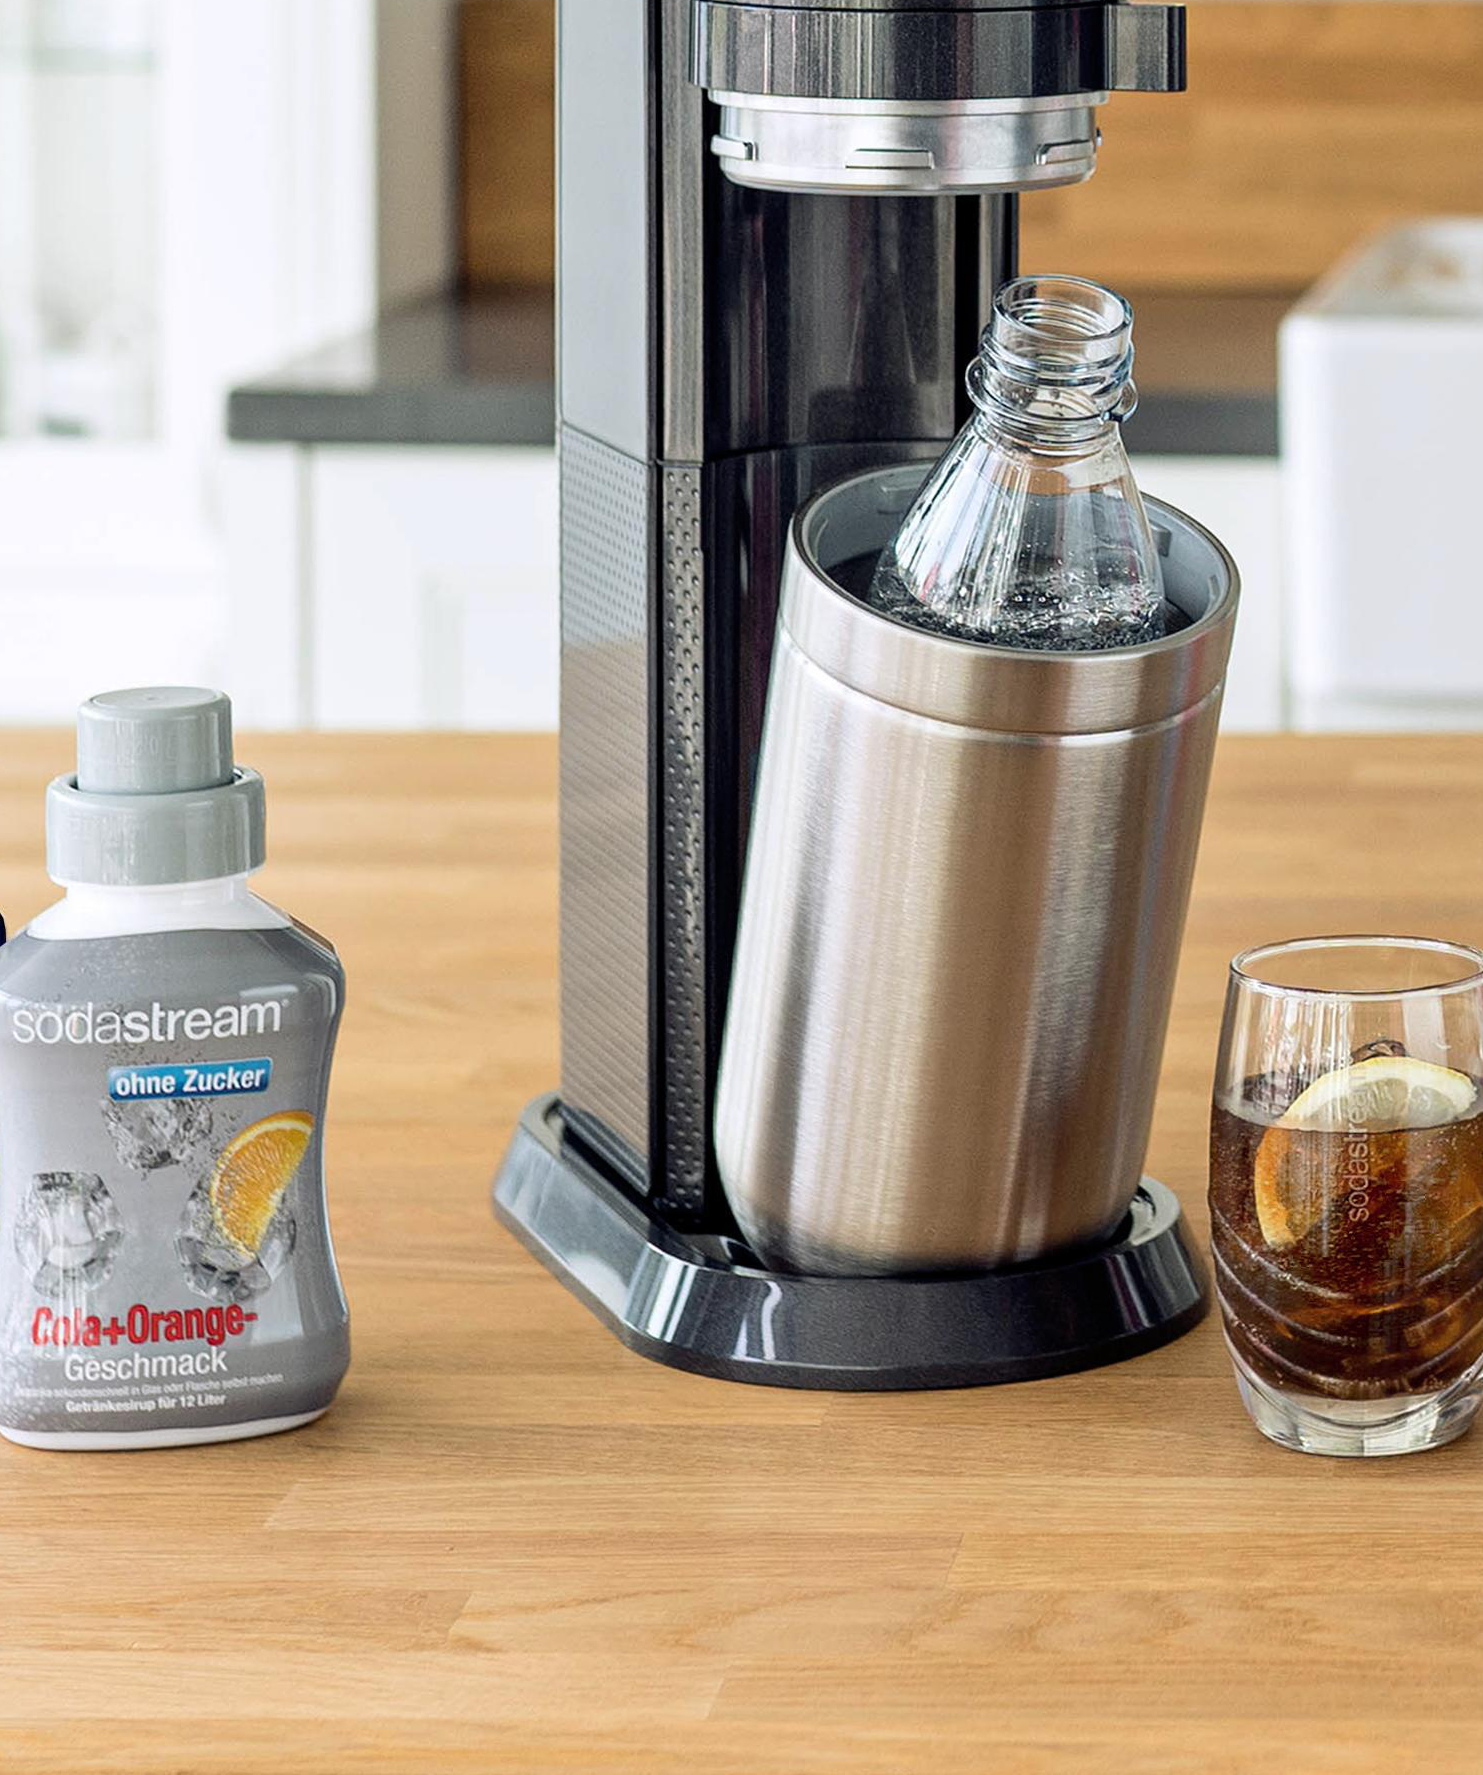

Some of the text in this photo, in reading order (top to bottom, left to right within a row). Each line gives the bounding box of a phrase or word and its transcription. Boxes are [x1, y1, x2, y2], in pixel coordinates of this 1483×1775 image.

[116, 1066, 266, 1097] ohne Zucker
[31, 1303, 259, 1347] Cola+Orange-
[64, 1346, 229, 1381] Geschmack
[157, 1395, 178, 1410] für
[180, 1394, 195, 1408] 12
[197, 1393, 227, 1407] Liter
